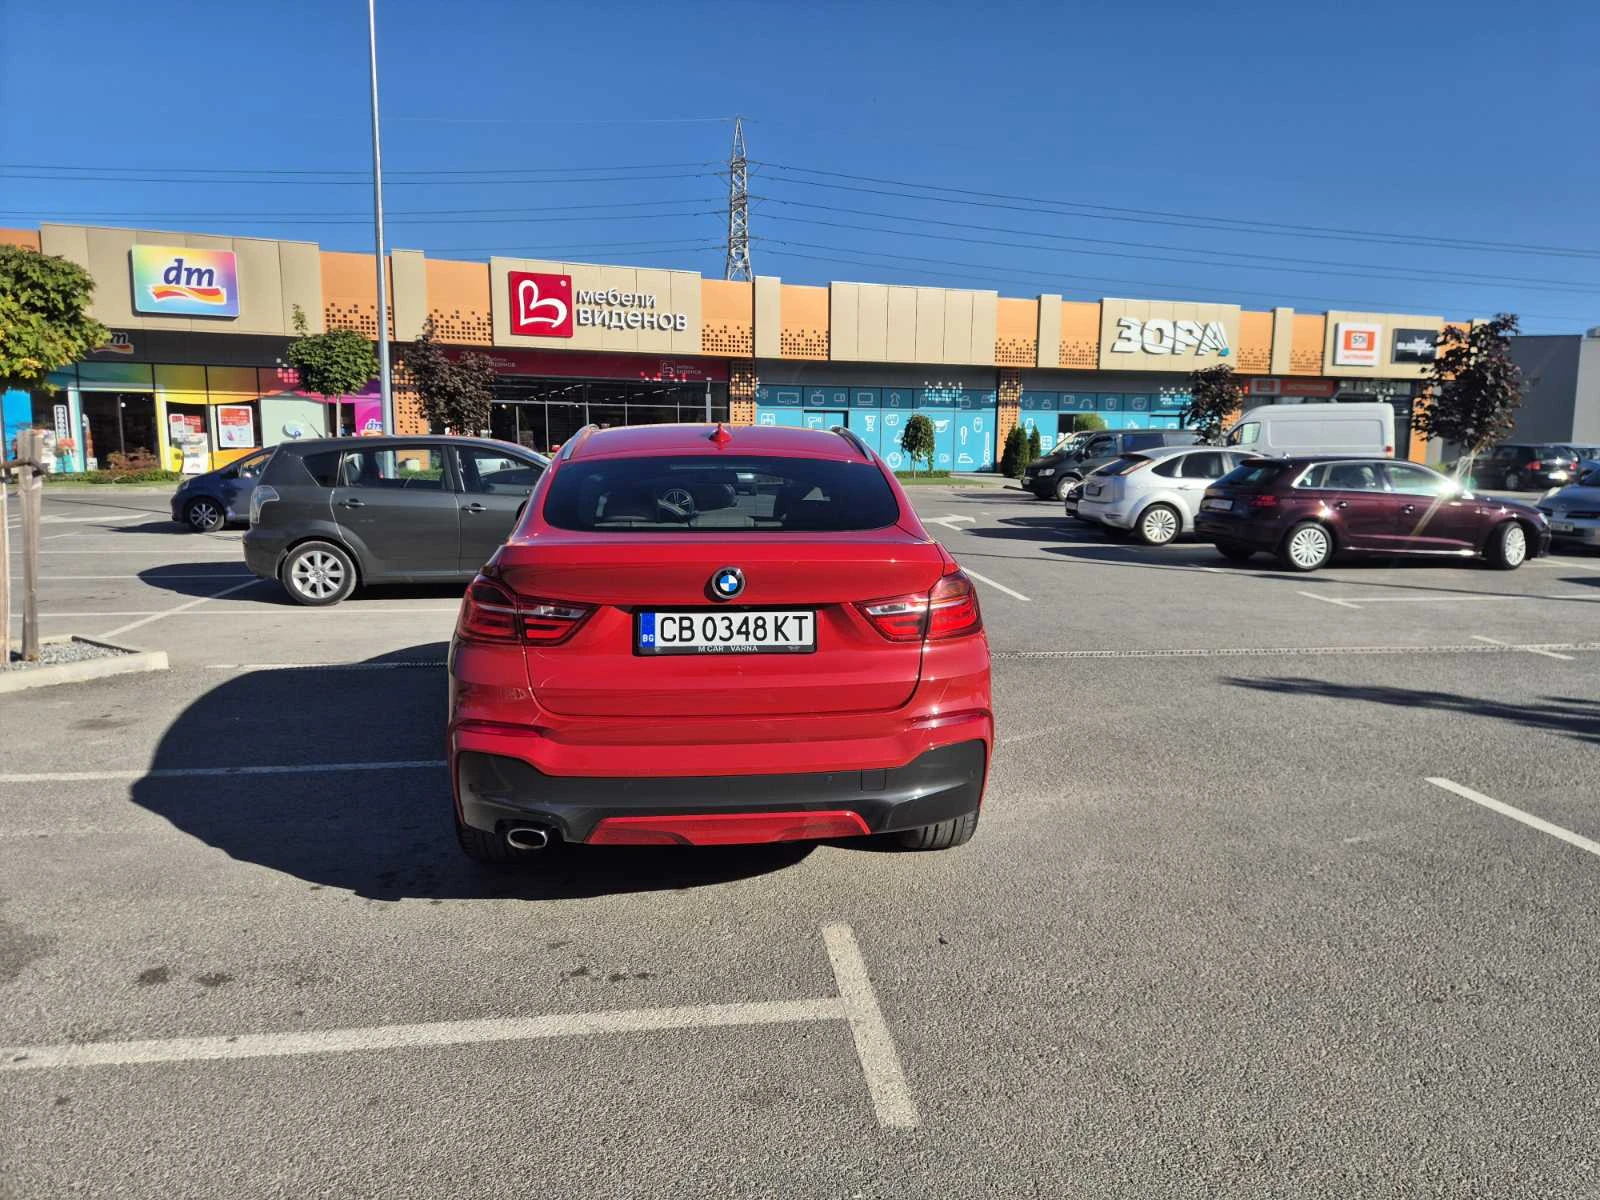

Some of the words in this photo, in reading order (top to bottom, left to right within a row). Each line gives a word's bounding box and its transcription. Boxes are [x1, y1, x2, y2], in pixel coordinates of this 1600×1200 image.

[163, 258, 214, 287] dm
[1111, 317, 1230, 356] ЗОРА
[642, 634, 654, 642] BG
[660, 616, 695, 642] CB
[702, 616, 768, 642] 0348
[774, 615, 809, 642] KT
